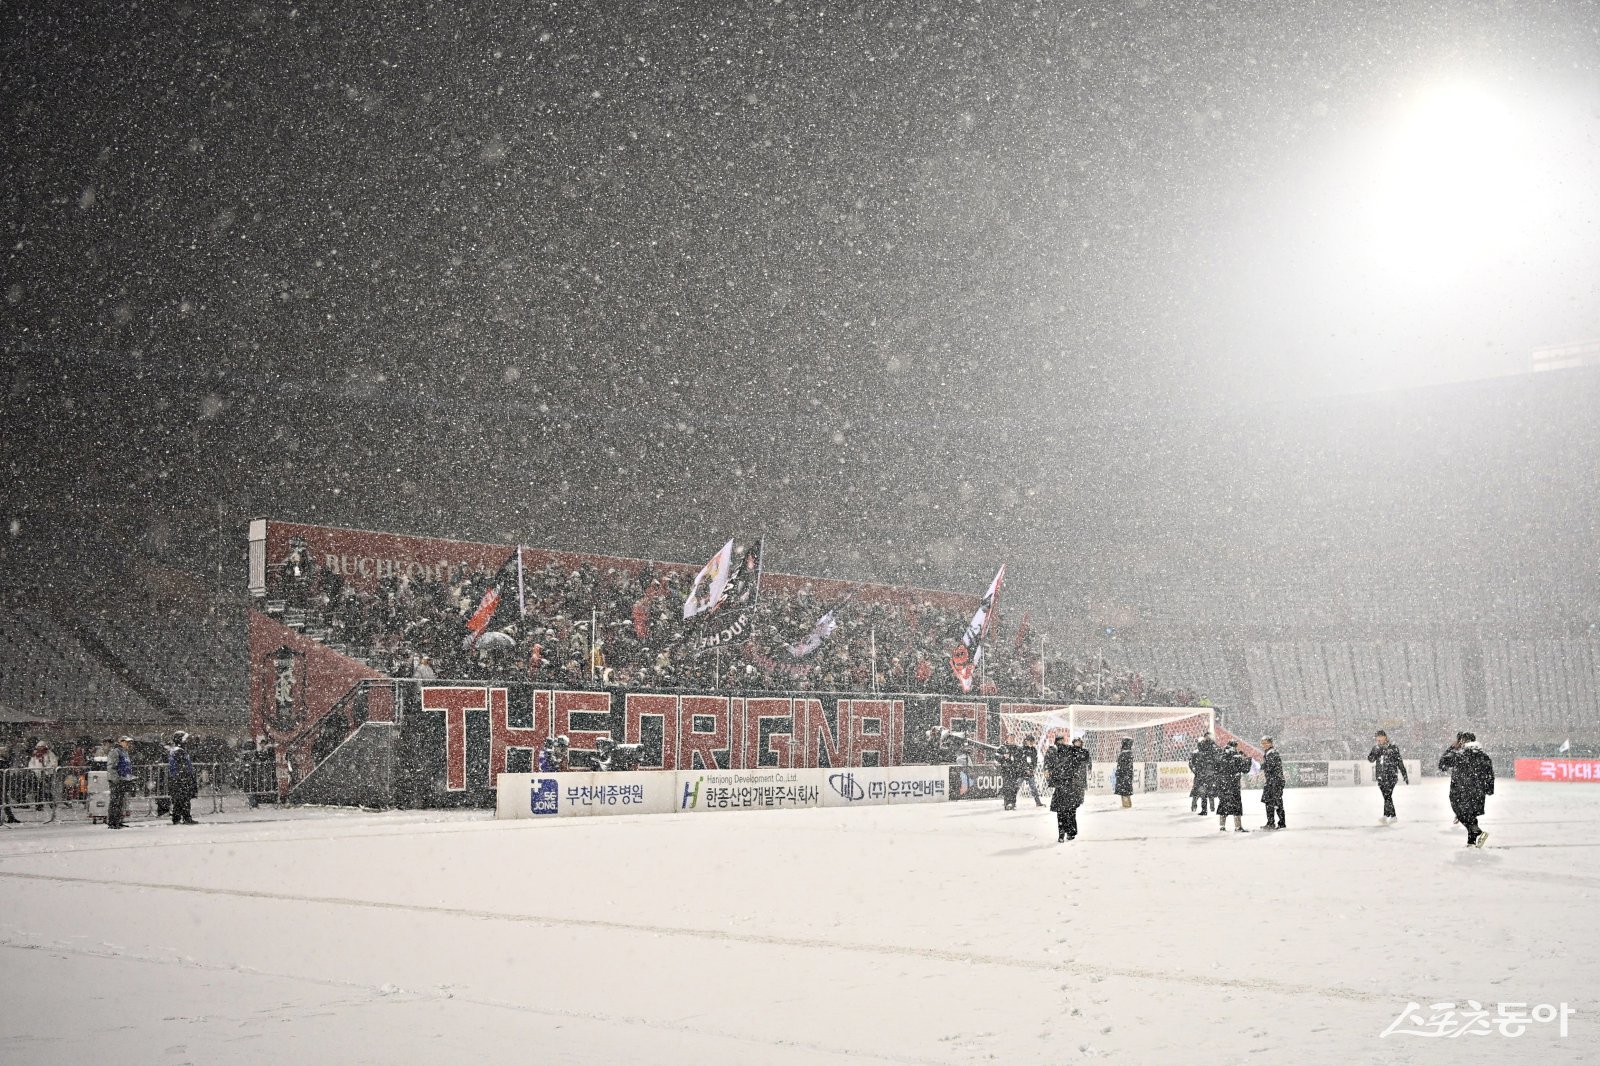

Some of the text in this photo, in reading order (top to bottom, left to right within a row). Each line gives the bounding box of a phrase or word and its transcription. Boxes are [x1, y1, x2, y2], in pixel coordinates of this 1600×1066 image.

[421, 686, 612, 791] THE
[624, 693, 930, 771] ORIGINAL
[707, 774, 733, 785] Hanjong
[734, 773, 774, 784] Development
[566, 784, 643, 806] 부천세종병원
[706, 785, 819, 808] 한종산업개발주식회사
